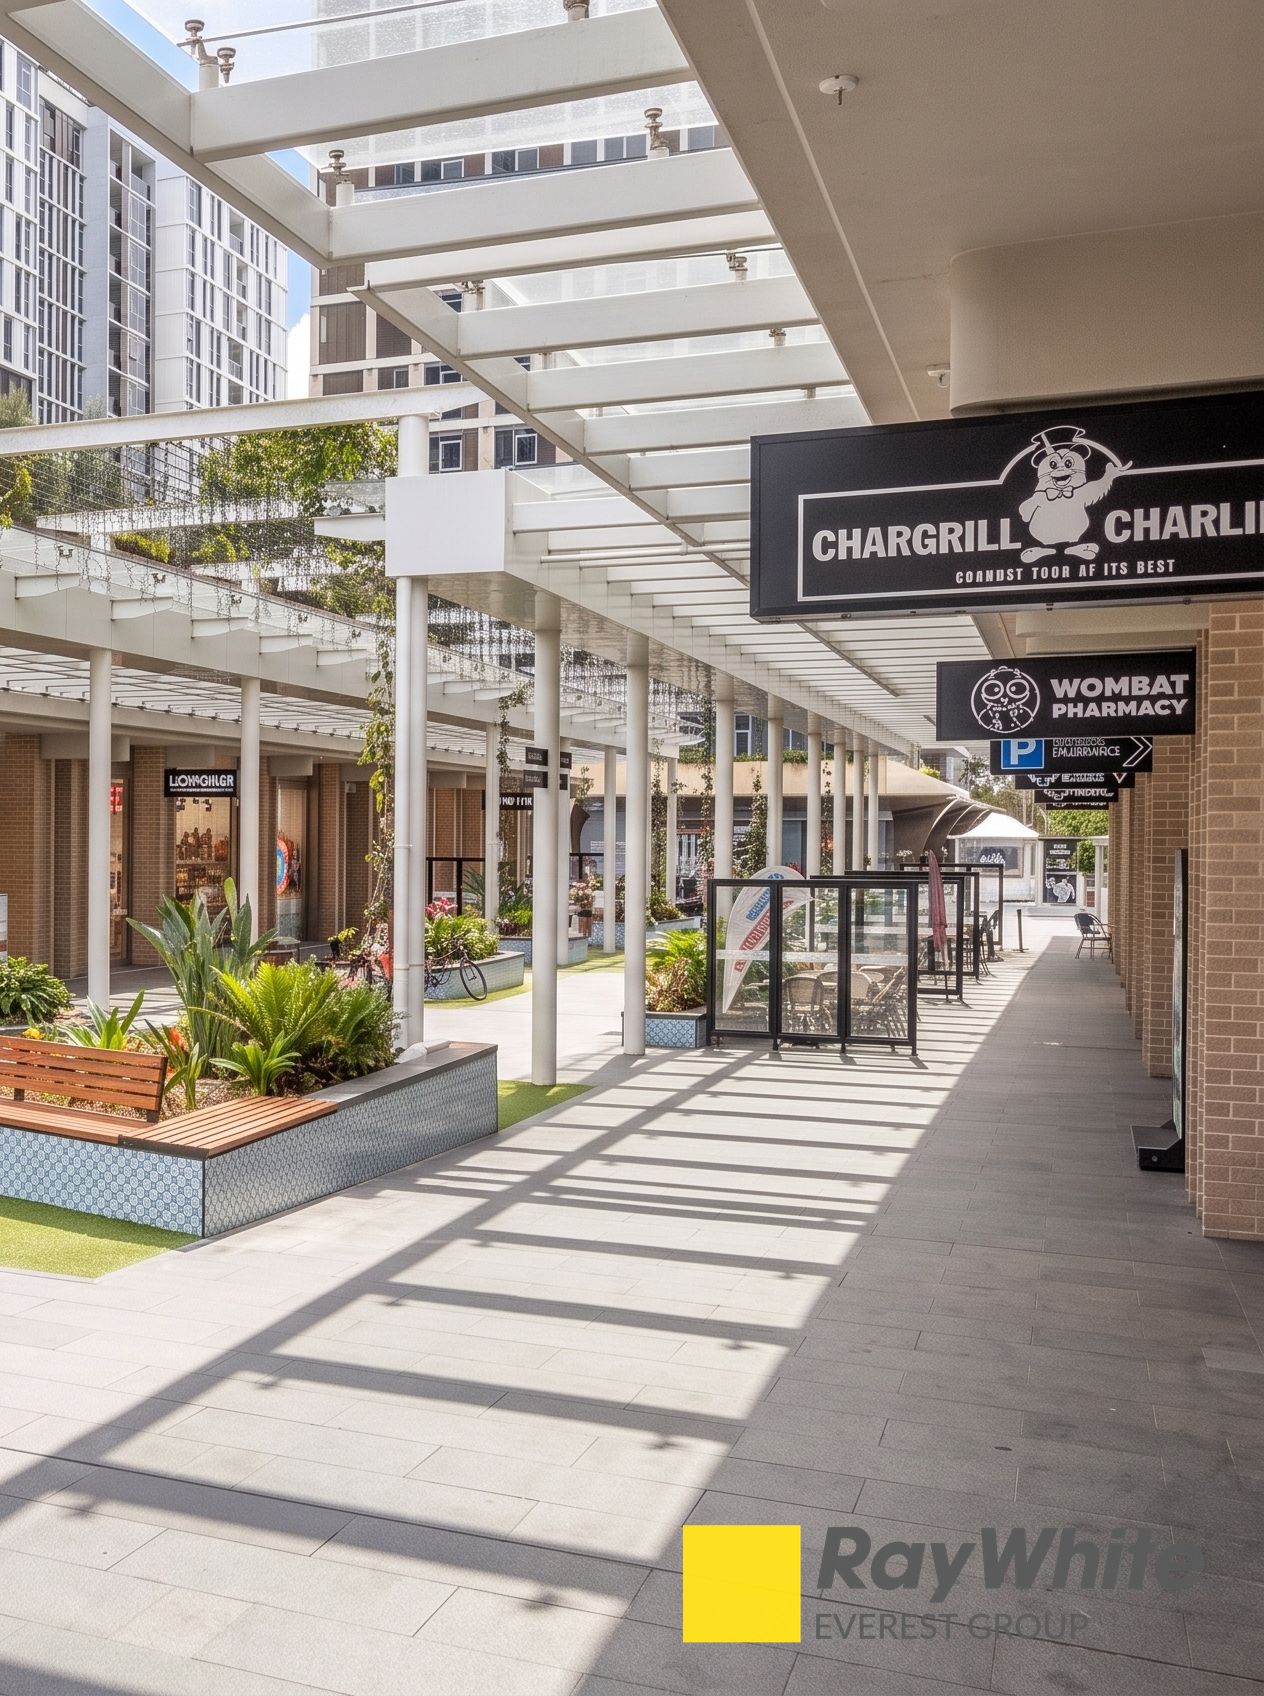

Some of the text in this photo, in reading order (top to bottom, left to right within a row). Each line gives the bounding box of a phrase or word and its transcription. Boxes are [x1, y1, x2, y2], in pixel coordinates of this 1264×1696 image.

[812, 500, 1264, 563] CHARGRILL CHARLI
[1032, 565, 1070, 580] TOOR
[1103, 562, 1128, 576] ITS
[1136, 559, 1175, 574] BEST
[1050, 674, 1189, 699] WOMBAT
[1052, 699, 1189, 719] PHARMACY
[1010, 739, 1036, 765] P
